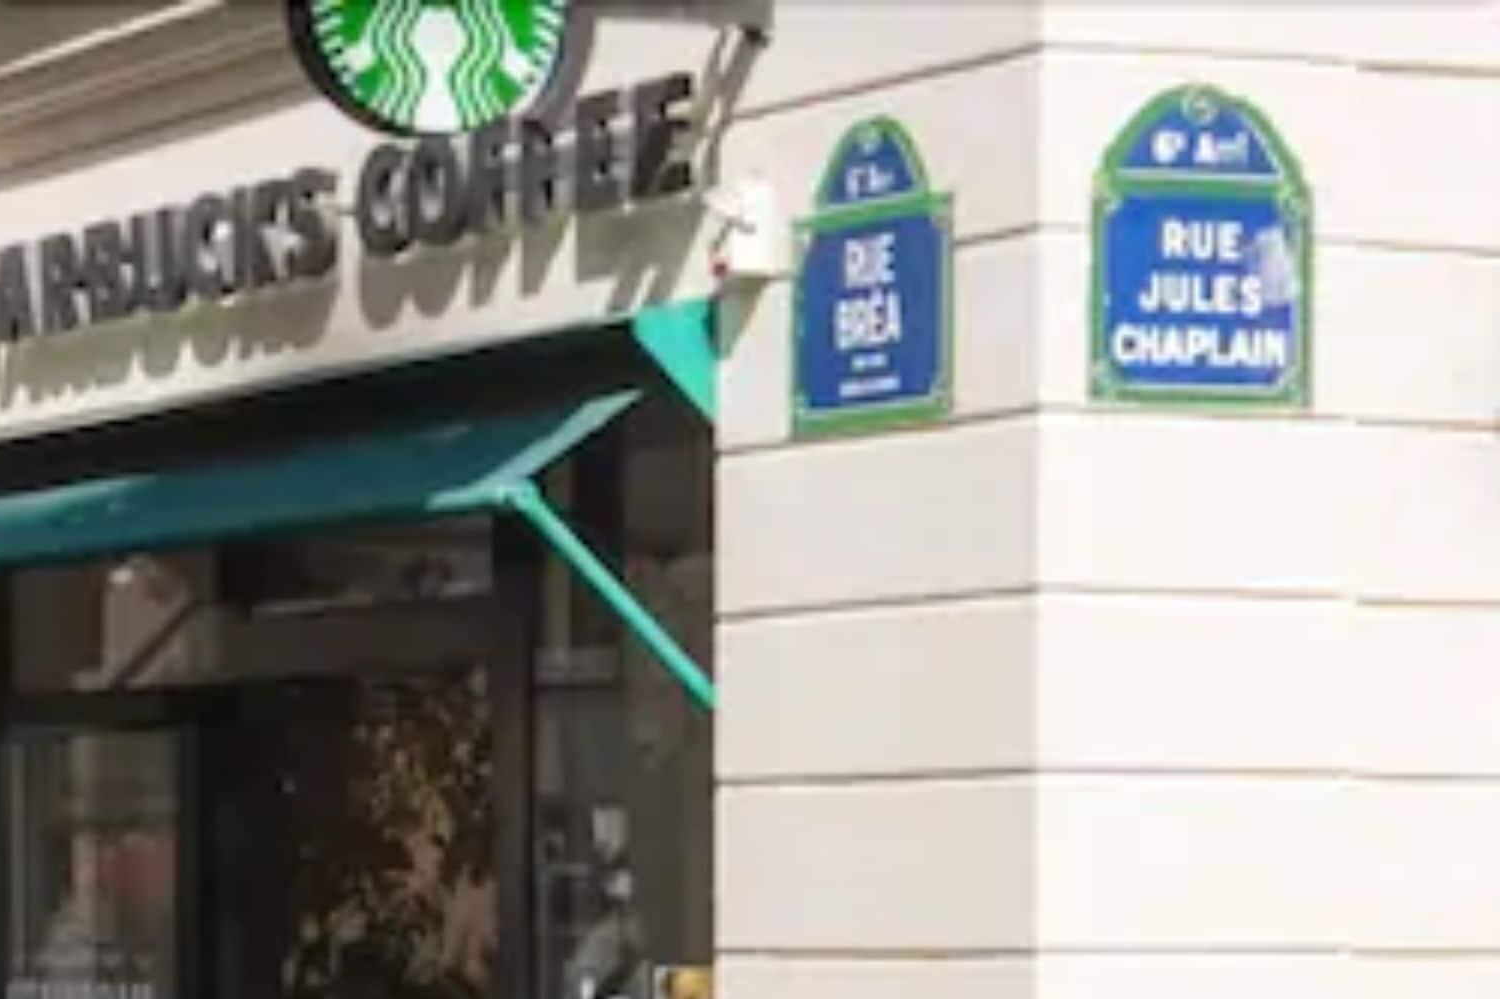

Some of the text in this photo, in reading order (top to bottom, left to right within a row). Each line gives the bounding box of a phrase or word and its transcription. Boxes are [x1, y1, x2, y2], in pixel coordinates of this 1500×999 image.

[359, 71, 694, 258] COFFEE
[845, 233, 897, 288] RUE
[1161, 218, 1243, 260] RUE
[1138, 273, 1262, 315] JULES
[1112, 323, 1287, 367] CHAPLAIN
